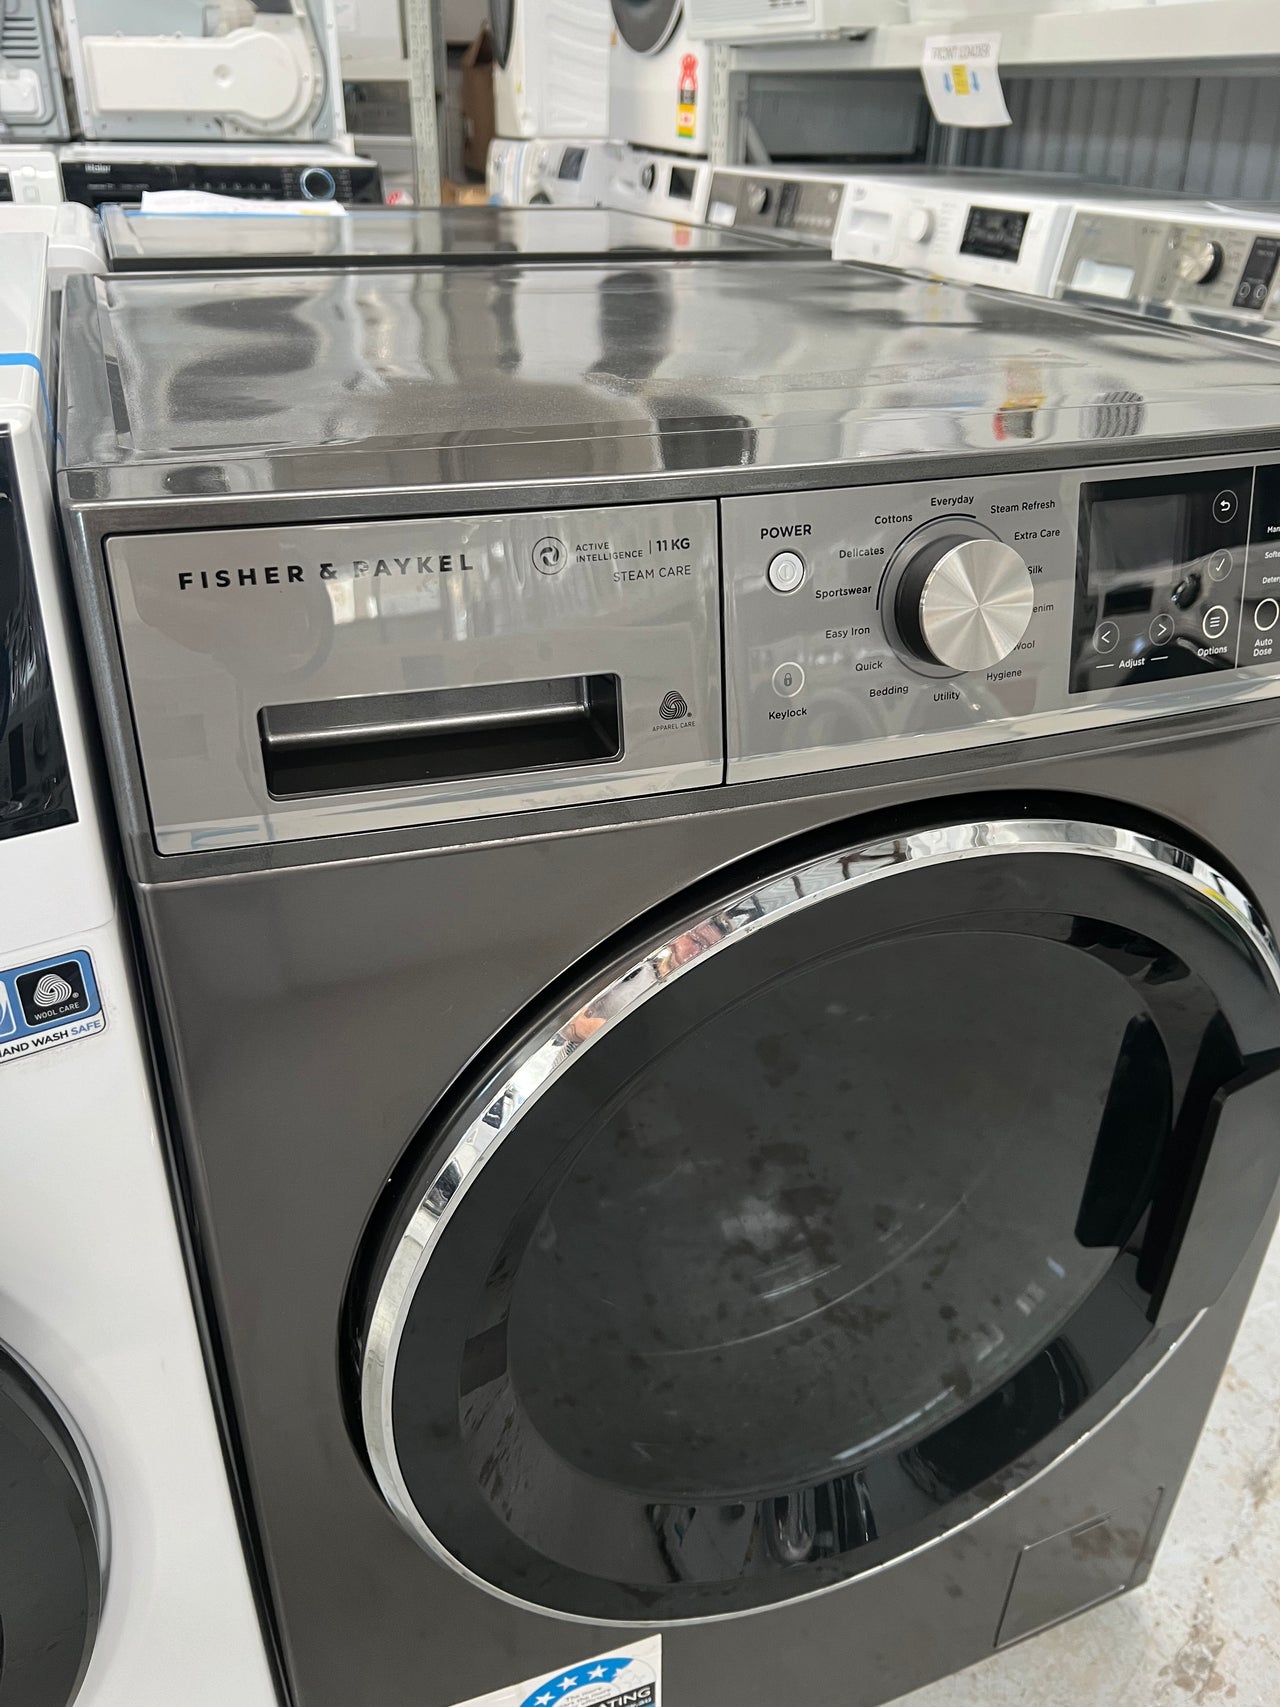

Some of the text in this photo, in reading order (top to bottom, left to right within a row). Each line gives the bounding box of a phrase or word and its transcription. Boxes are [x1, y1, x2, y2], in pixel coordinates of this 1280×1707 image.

[931, 495, 974, 507] Everyday
[990, 500, 1056, 514] Steam Refresh
[874, 514, 913, 525] Cottons
[760, 524, 812, 539] POWER
[1014, 528, 1061, 541] Extra Care
[575, 542, 609, 552] ACTIVE
[656, 538, 690, 552] 11 KG
[576, 550, 643, 563] INTELLIGENCE
[839, 547, 885, 559] Delicates
[178, 554, 474, 590] FISHER & PAYKEL
[613, 565, 691, 582] STEAM CARE
[1028, 565, 1043, 575] Silk
[815, 585, 872, 600] Sportswear
[1033, 603, 1054, 613] enim
[825, 626, 870, 639] Easy Iron
[1254, 638, 1273, 647] Auto
[1197, 645, 1228, 657] Options
[1253, 647, 1273, 657] Dose
[855, 661, 883, 672] Quick
[1118, 657, 1145, 668] Adjust
[986, 669, 1022, 682] Hygiene
[869, 685, 909, 698] Bedding
[933, 690, 961, 702] Utility
[768, 707, 808, 720] Keylock
[652, 721, 696, 732] APPAREL CARE
[34, 1002, 80, 1020] WOOL CARE
[31, 1030, 69, 1047] WASH
[70, 1019, 102, 1036] SAFE
